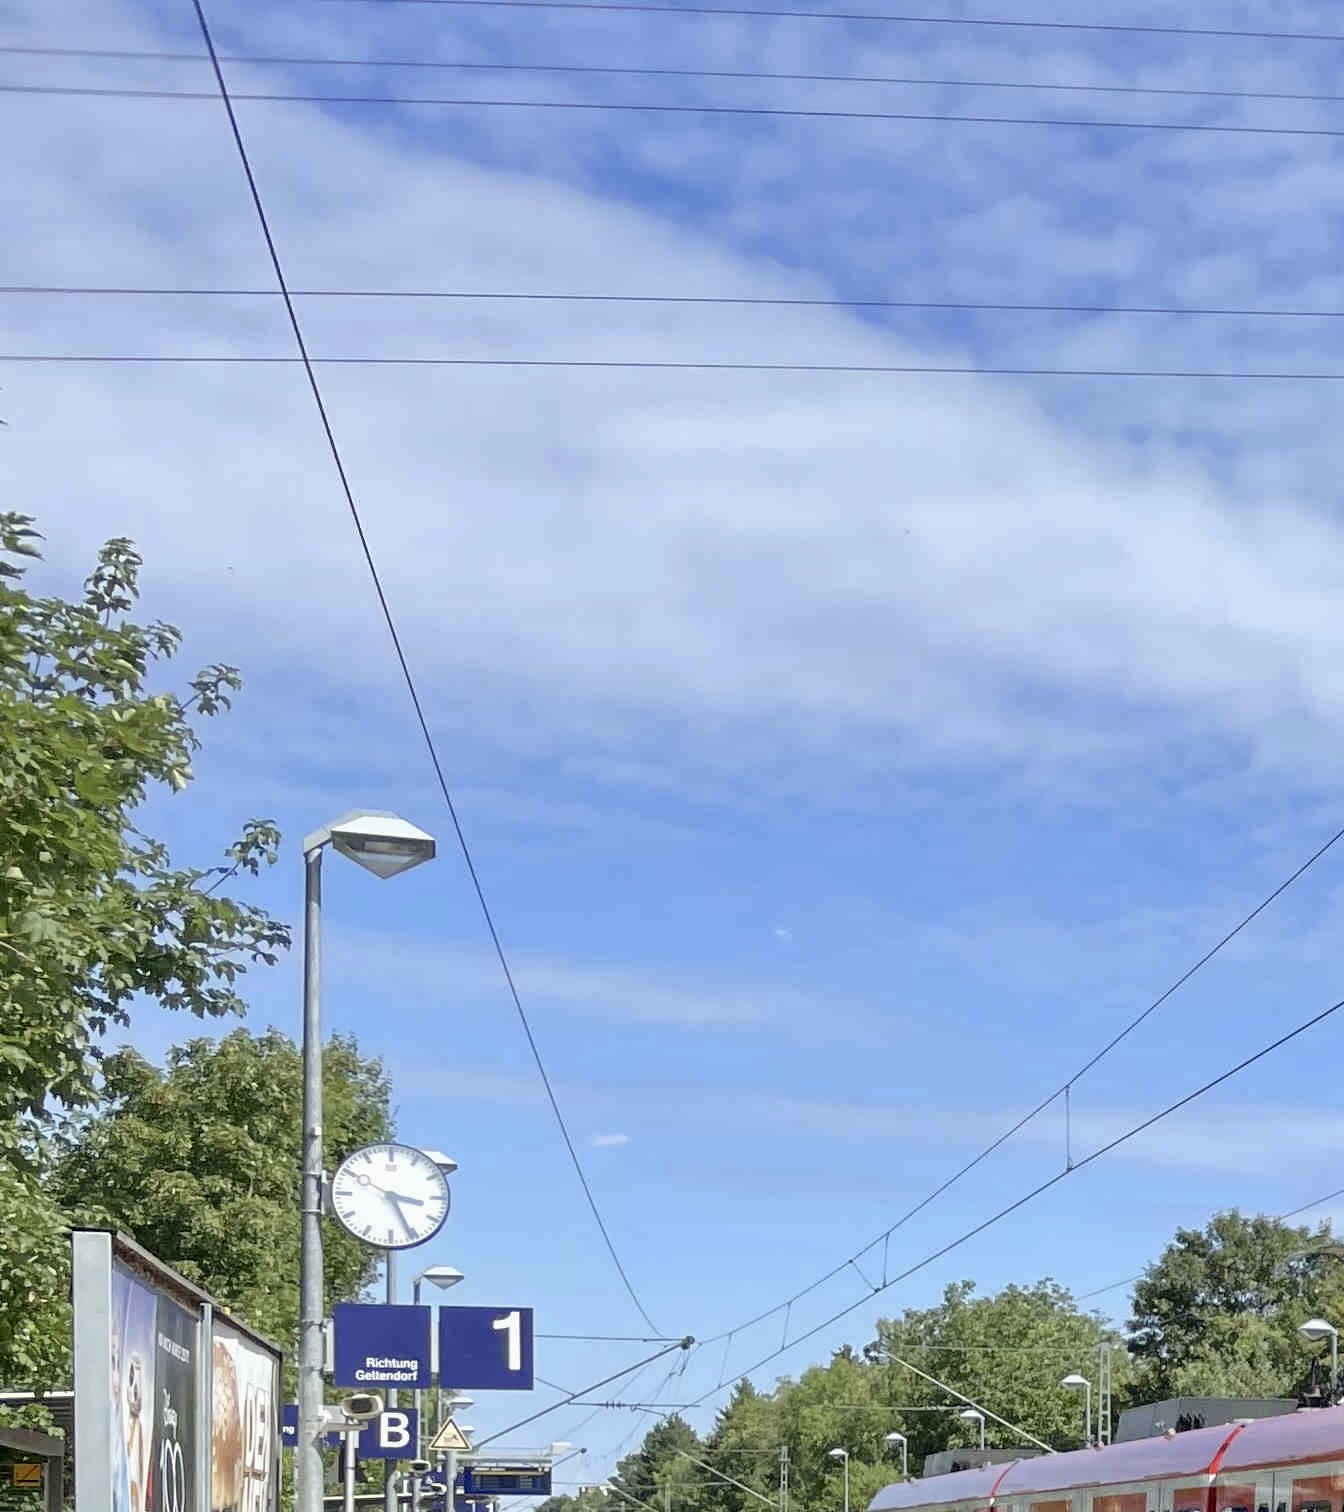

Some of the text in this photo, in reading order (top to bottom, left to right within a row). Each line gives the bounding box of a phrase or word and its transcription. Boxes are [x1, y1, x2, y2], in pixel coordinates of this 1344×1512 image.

[493, 1311, 521, 1371] 1
[355, 1369, 418, 1381] Geltendorf
[365, 1357, 418, 1371] Richtung
[379, 1411, 410, 1448] B
